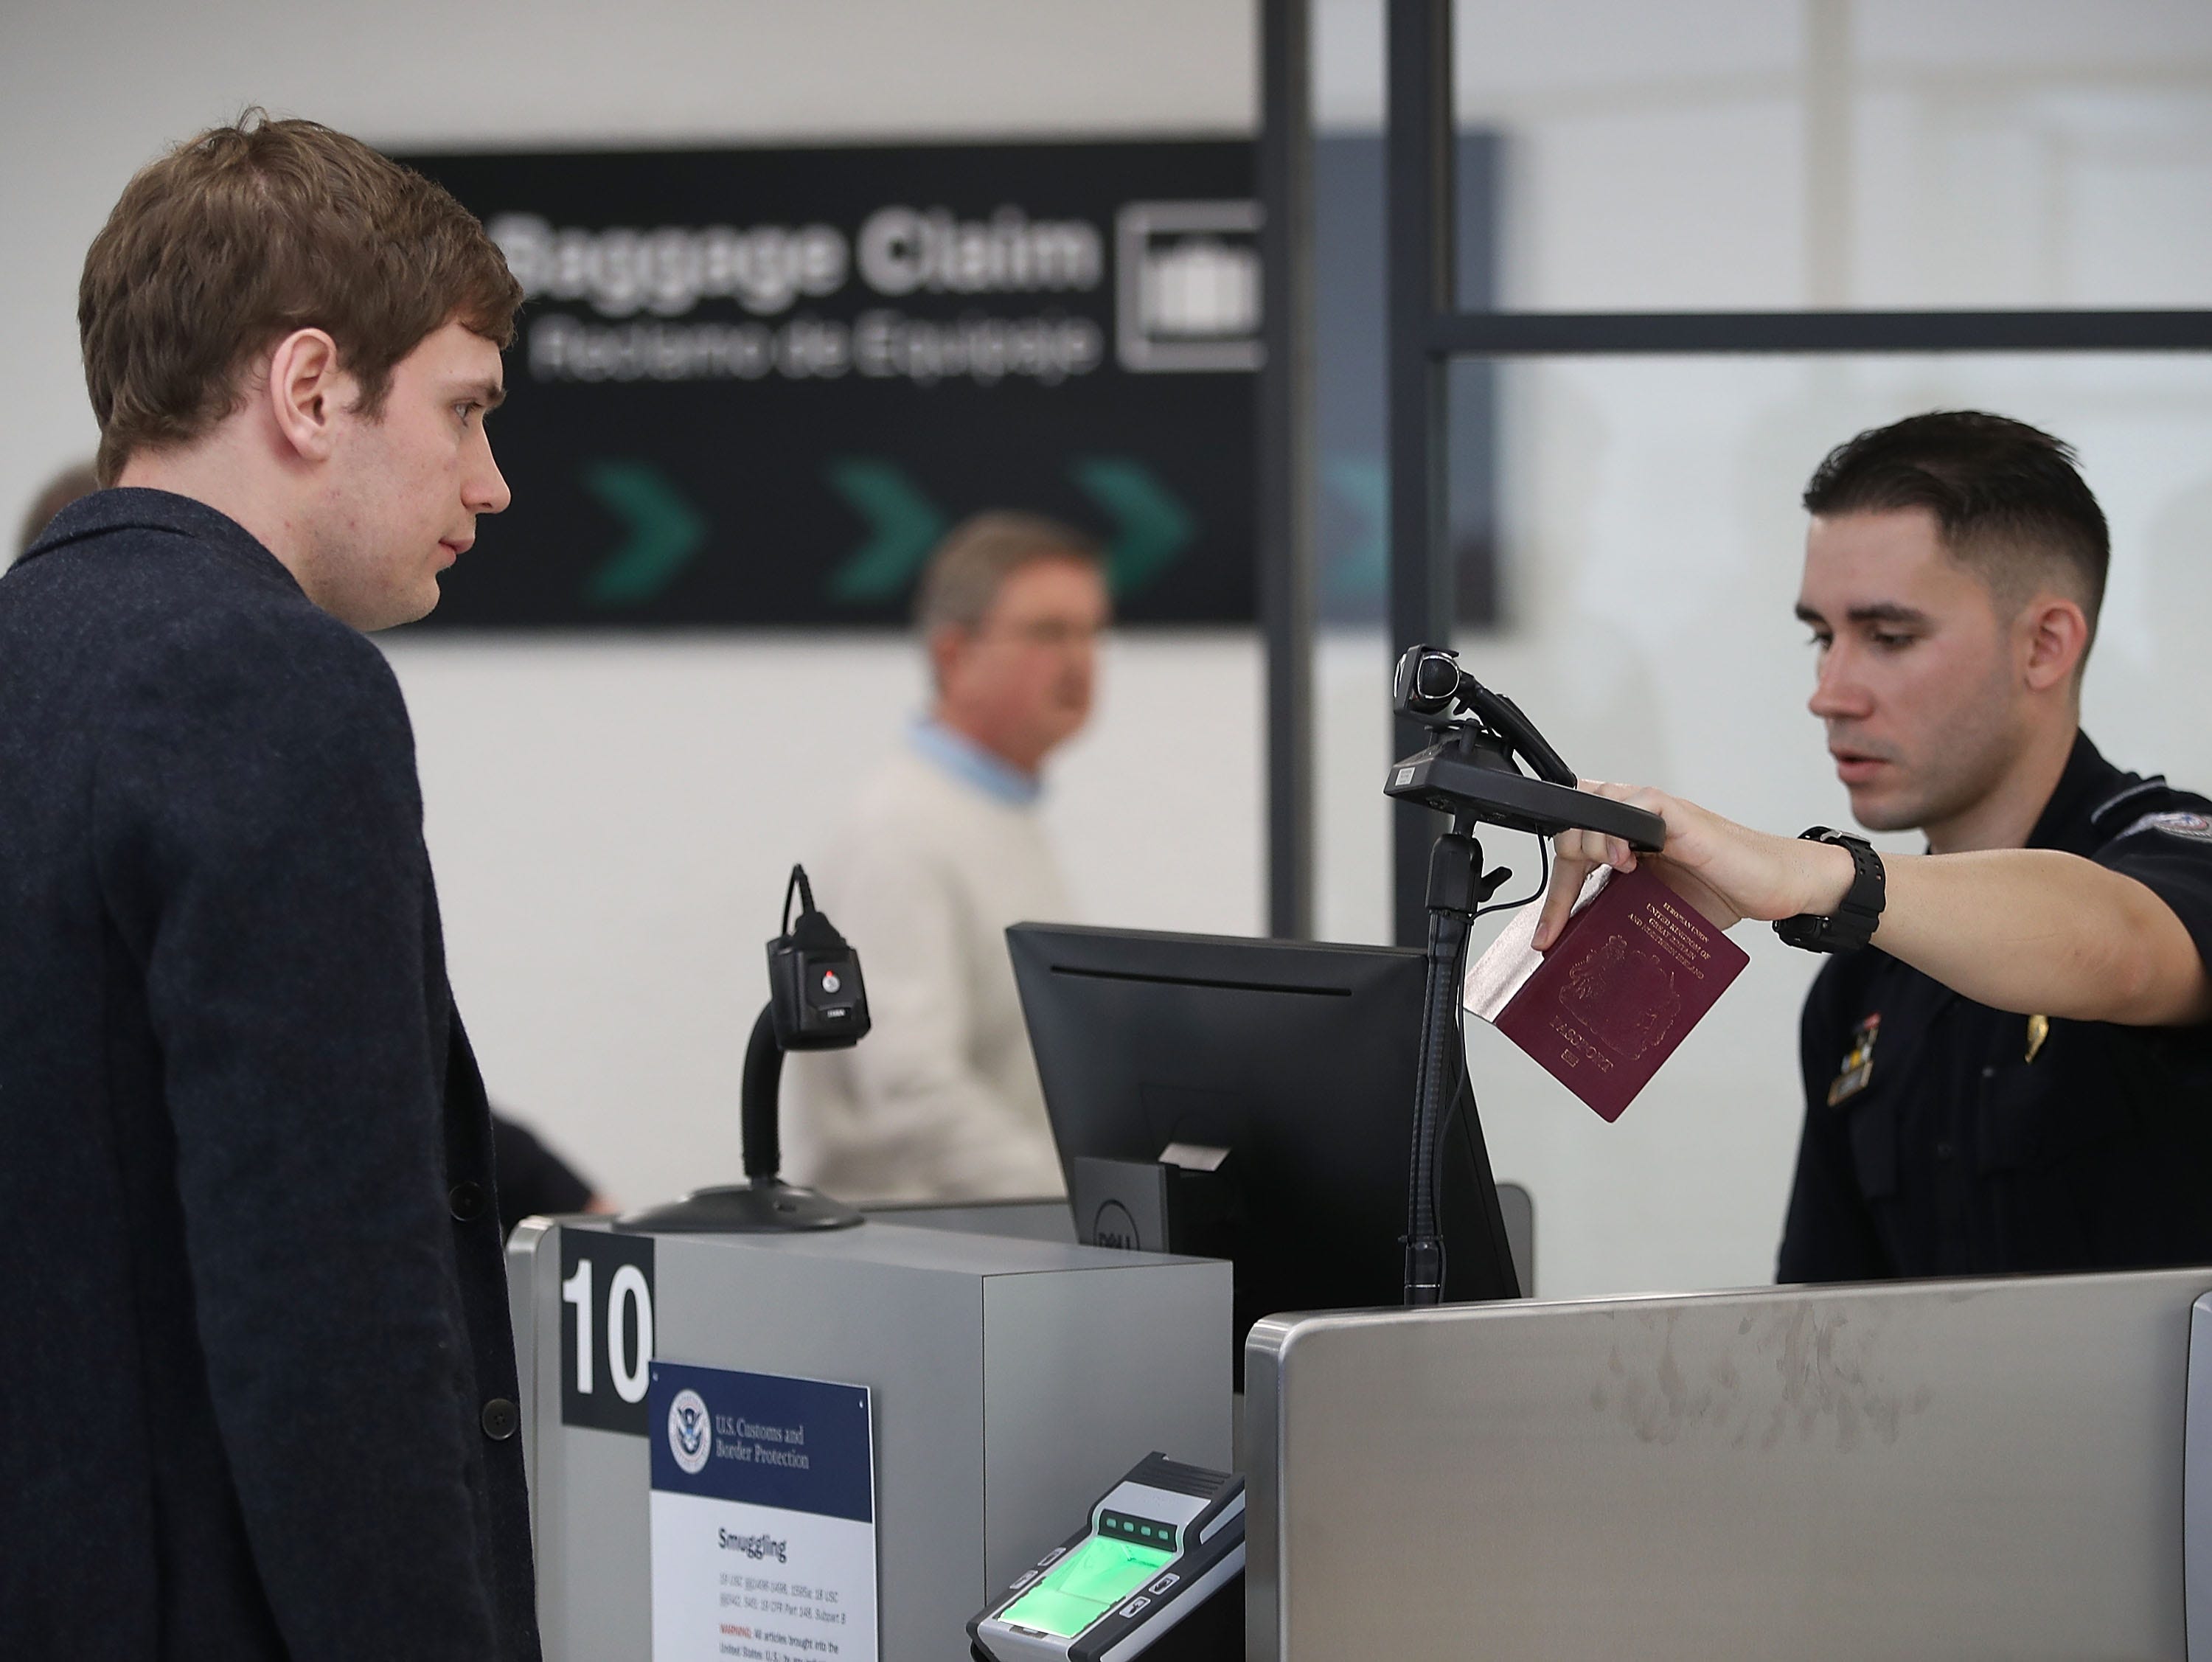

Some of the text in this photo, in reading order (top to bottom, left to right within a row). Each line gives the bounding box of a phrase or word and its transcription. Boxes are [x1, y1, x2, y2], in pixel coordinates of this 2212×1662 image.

[490, 205, 1103, 316] Baggage Claim
[529, 310, 1103, 386] Reclamo de Equipaje
[1628, 913, 1644, 926] AND
[1646, 903, 1711, 959] UNITED KINGDOM OF
[1549, 1015, 1614, 1073] PASSPORT
[562, 1258, 653, 1403] 10
[715, 1414, 804, 1445] U.S. Customs and
[715, 1439, 810, 1470] Border Protection
[717, 1527, 787, 1563] Smuggling
[764, 1630, 787, 1645] articles
[787, 1635, 813, 1651] brought
[827, 1641, 838, 1655] the
